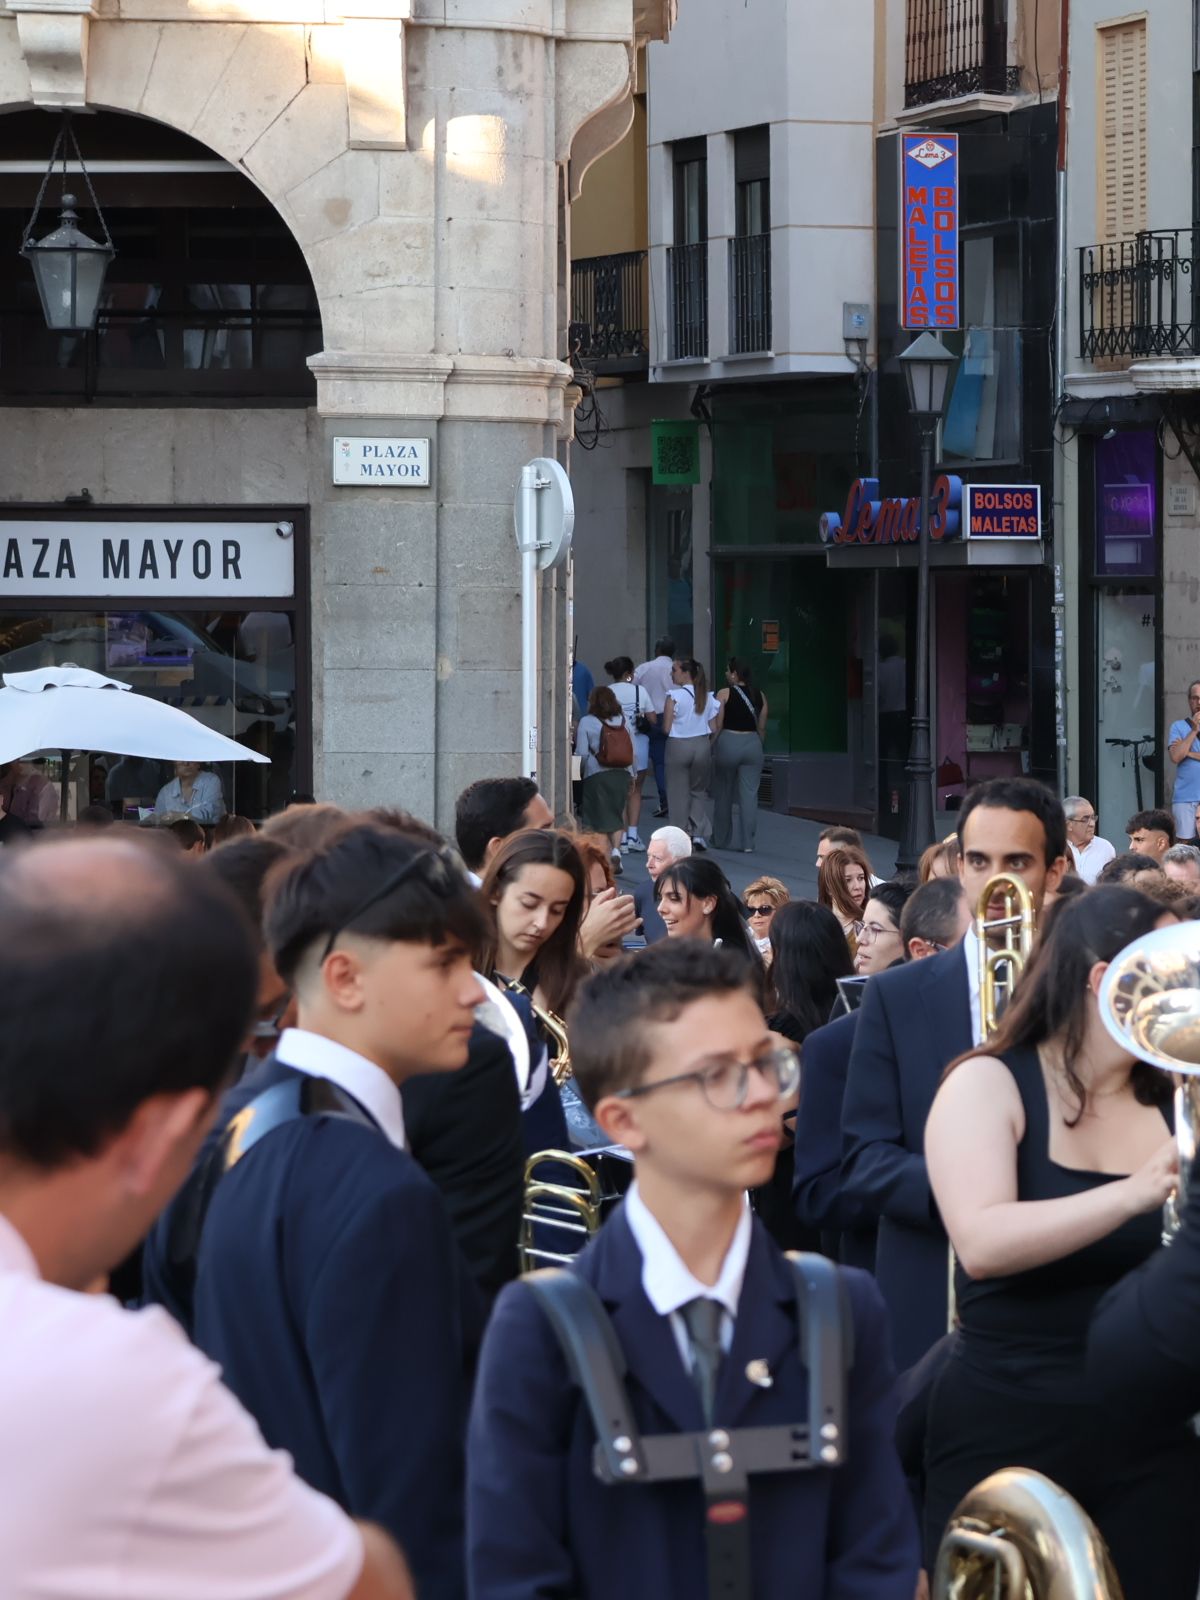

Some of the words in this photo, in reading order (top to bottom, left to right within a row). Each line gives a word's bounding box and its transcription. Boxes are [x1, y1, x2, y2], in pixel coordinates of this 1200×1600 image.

[915, 148, 939, 158] Lema
[940, 150, 946, 160] 3
[907, 187, 928, 324] MALETAS
[933, 187, 955, 325] BOLSOS
[362, 445, 418, 458] PLAZA
[360, 464, 421, 477] MAYOR
[833, 478, 925, 544] Lema
[929, 474, 954, 540] 3
[974, 493, 1033, 509] BOLSOS
[971, 516, 1037, 533] MALETAS
[2, 538, 76, 578] AZA
[102, 538, 242, 580] MAYOR
